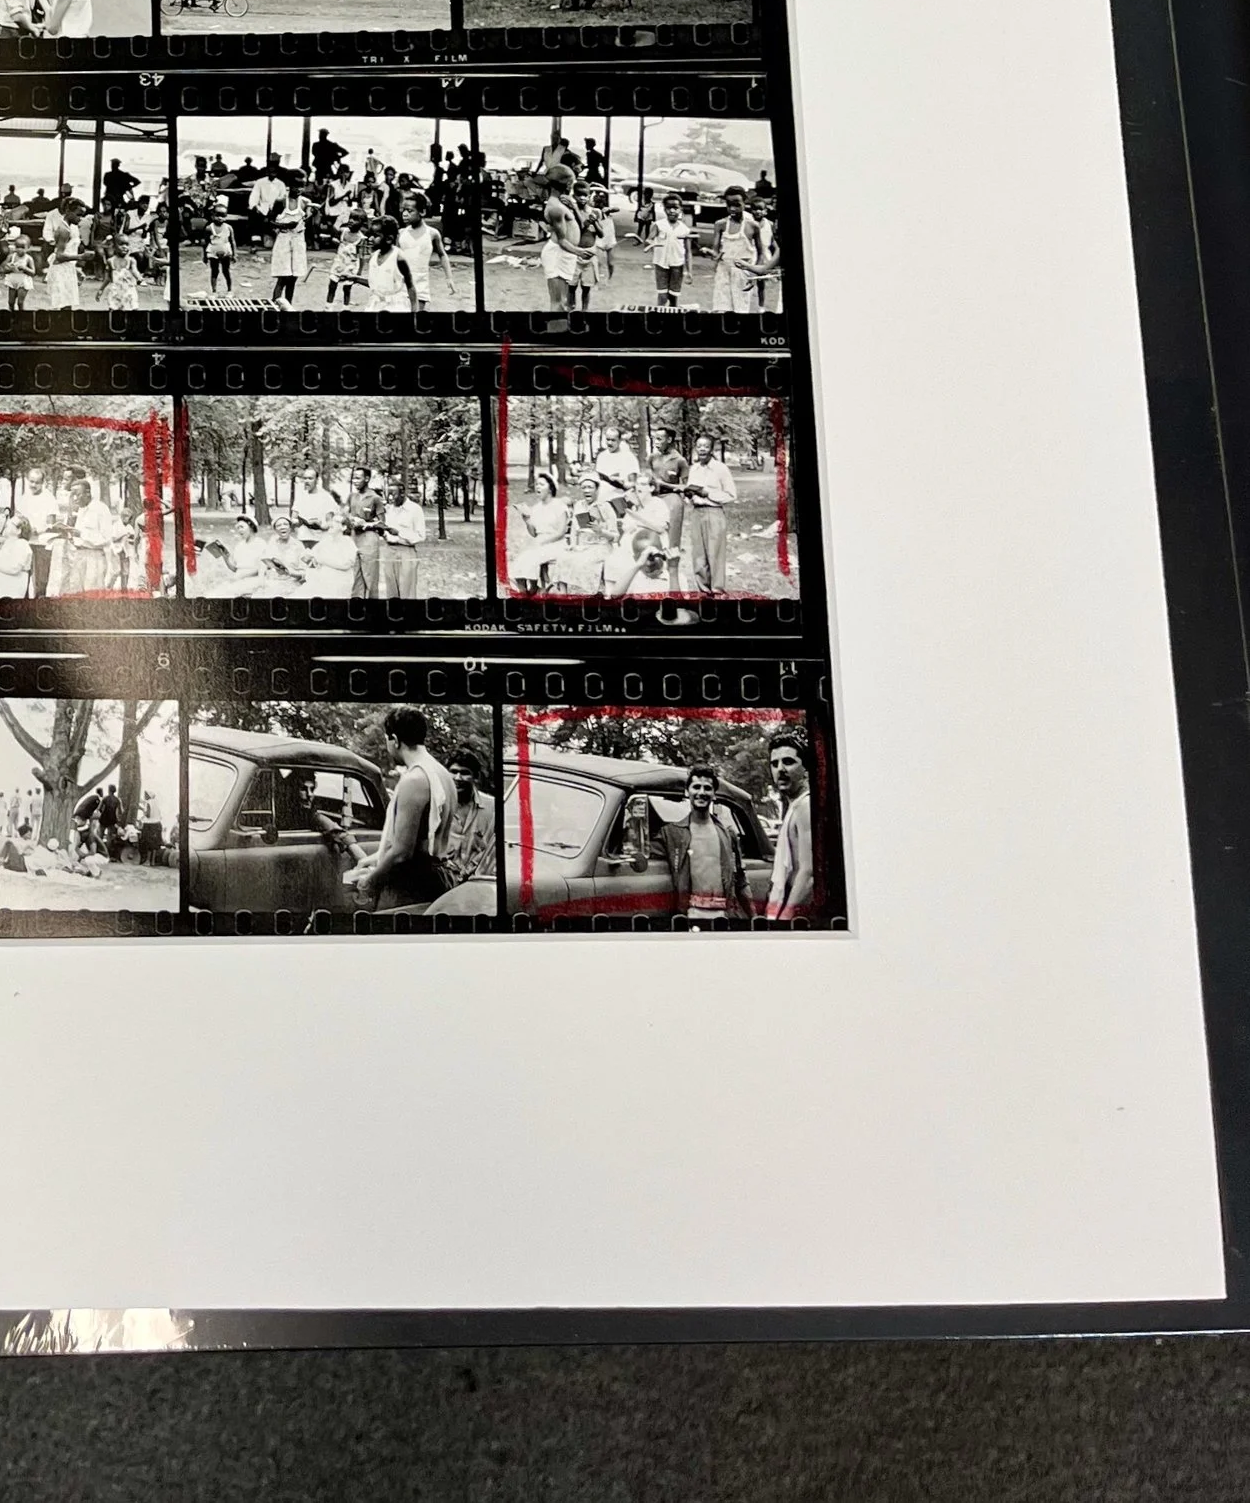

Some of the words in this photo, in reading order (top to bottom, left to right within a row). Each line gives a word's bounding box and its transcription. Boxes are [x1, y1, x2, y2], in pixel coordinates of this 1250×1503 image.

[434, 54, 468, 63] FILM
[139, 73, 164, 86] 43
[760, 336, 786, 345] KOD
[464, 623, 506, 632] KODAK
[157, 652, 170, 667] 9
[463, 657, 487, 672] 10
